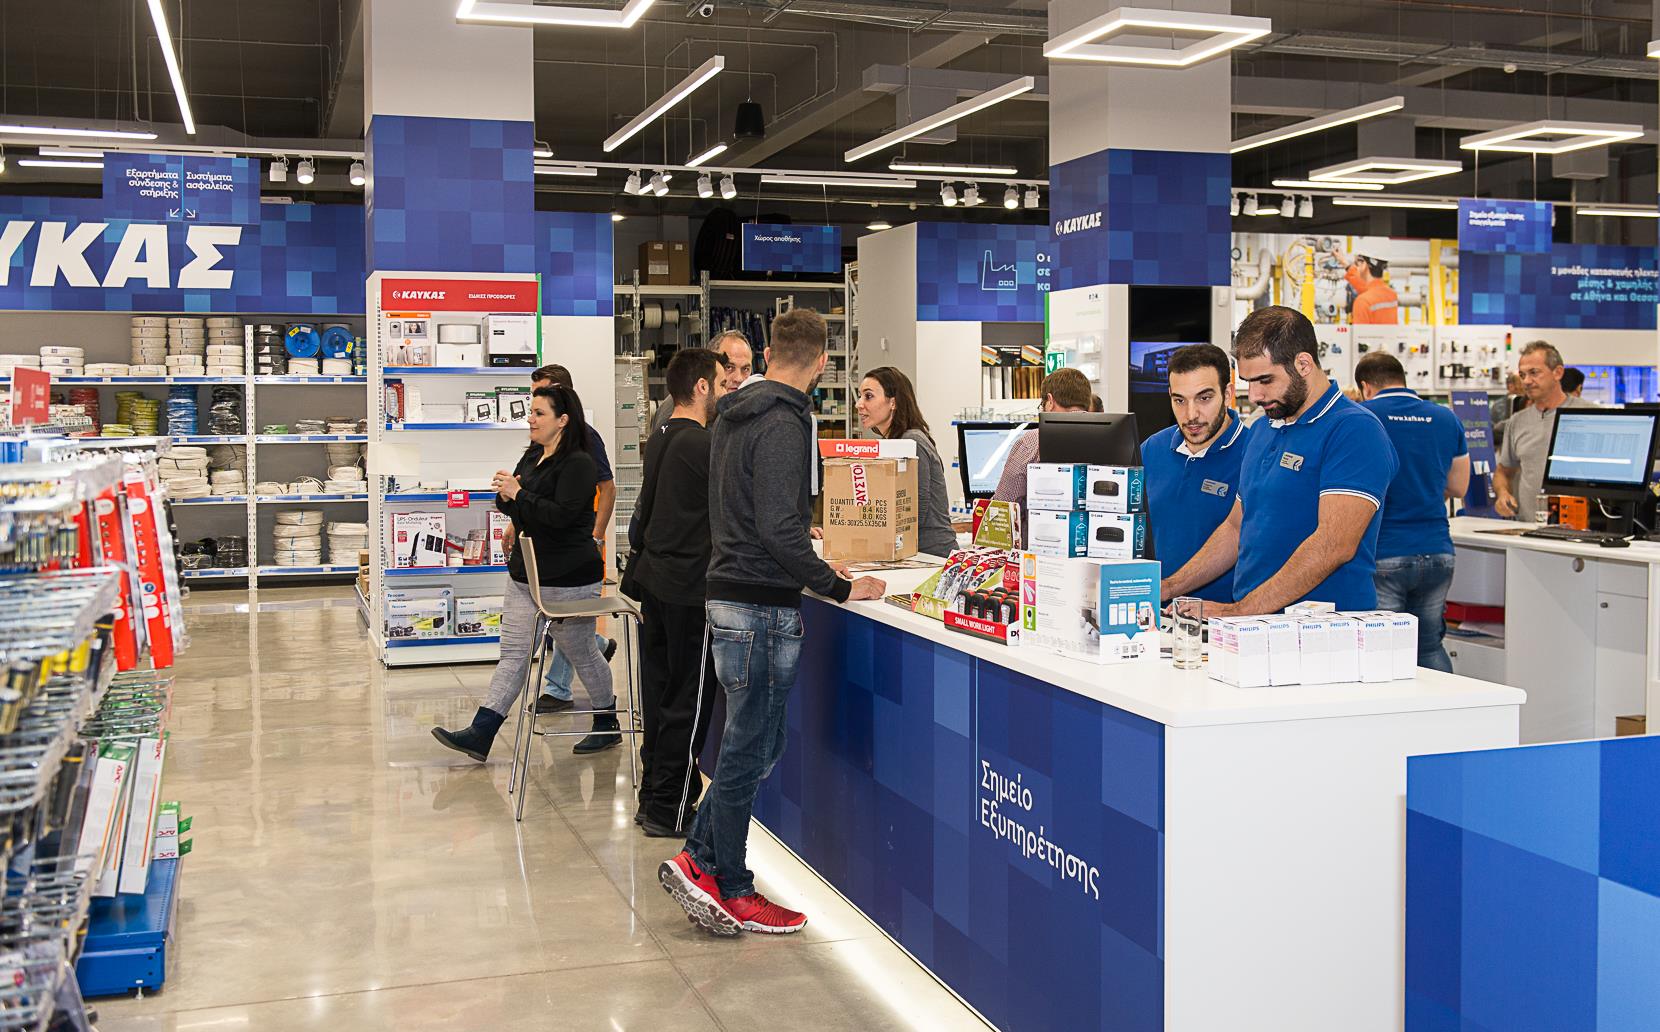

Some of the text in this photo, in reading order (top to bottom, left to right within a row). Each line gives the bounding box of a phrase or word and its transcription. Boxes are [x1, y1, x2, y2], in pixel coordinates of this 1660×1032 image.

[126, 169, 179, 179] Εξαρτήματα
[186, 171, 232, 181] Συστήματα
[128, 179, 171, 189] σύνδεσης
[186, 182, 233, 192] ασφαλείας
[140, 188, 179, 198] στήριξης
[1063, 212, 1101, 234] ΚΑΥΚΑΣ
[754, 234, 773, 242] Χώρος
[1607, 279, 1613, 288] &
[402, 291, 445, 299] ΚΑΥΚΑΣ
[845, 444, 879, 454] legrand
[955, 616, 995, 634] SMALL WORK LIGHT
[981, 759, 1033, 811] Σημείο
[981, 797, 1100, 900] Εξυπηρέτησης
